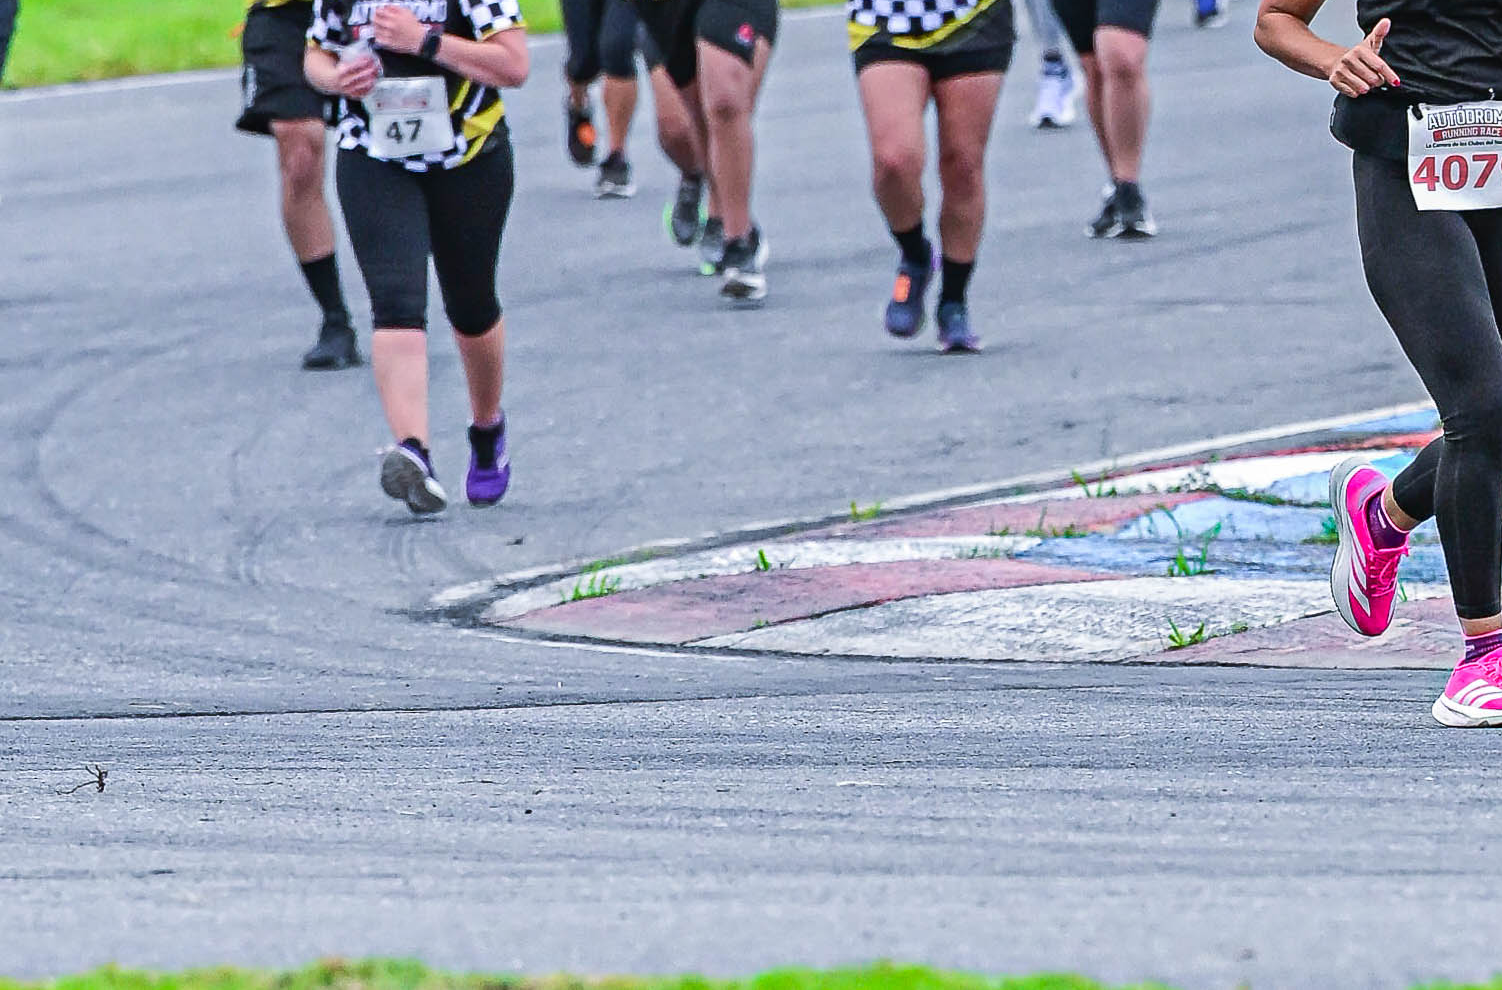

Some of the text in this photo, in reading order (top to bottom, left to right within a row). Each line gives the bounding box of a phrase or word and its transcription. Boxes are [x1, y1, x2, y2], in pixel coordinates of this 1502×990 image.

[387, 118, 424, 144] 47
[1441, 126, 1502, 139] RUNNING RACE
